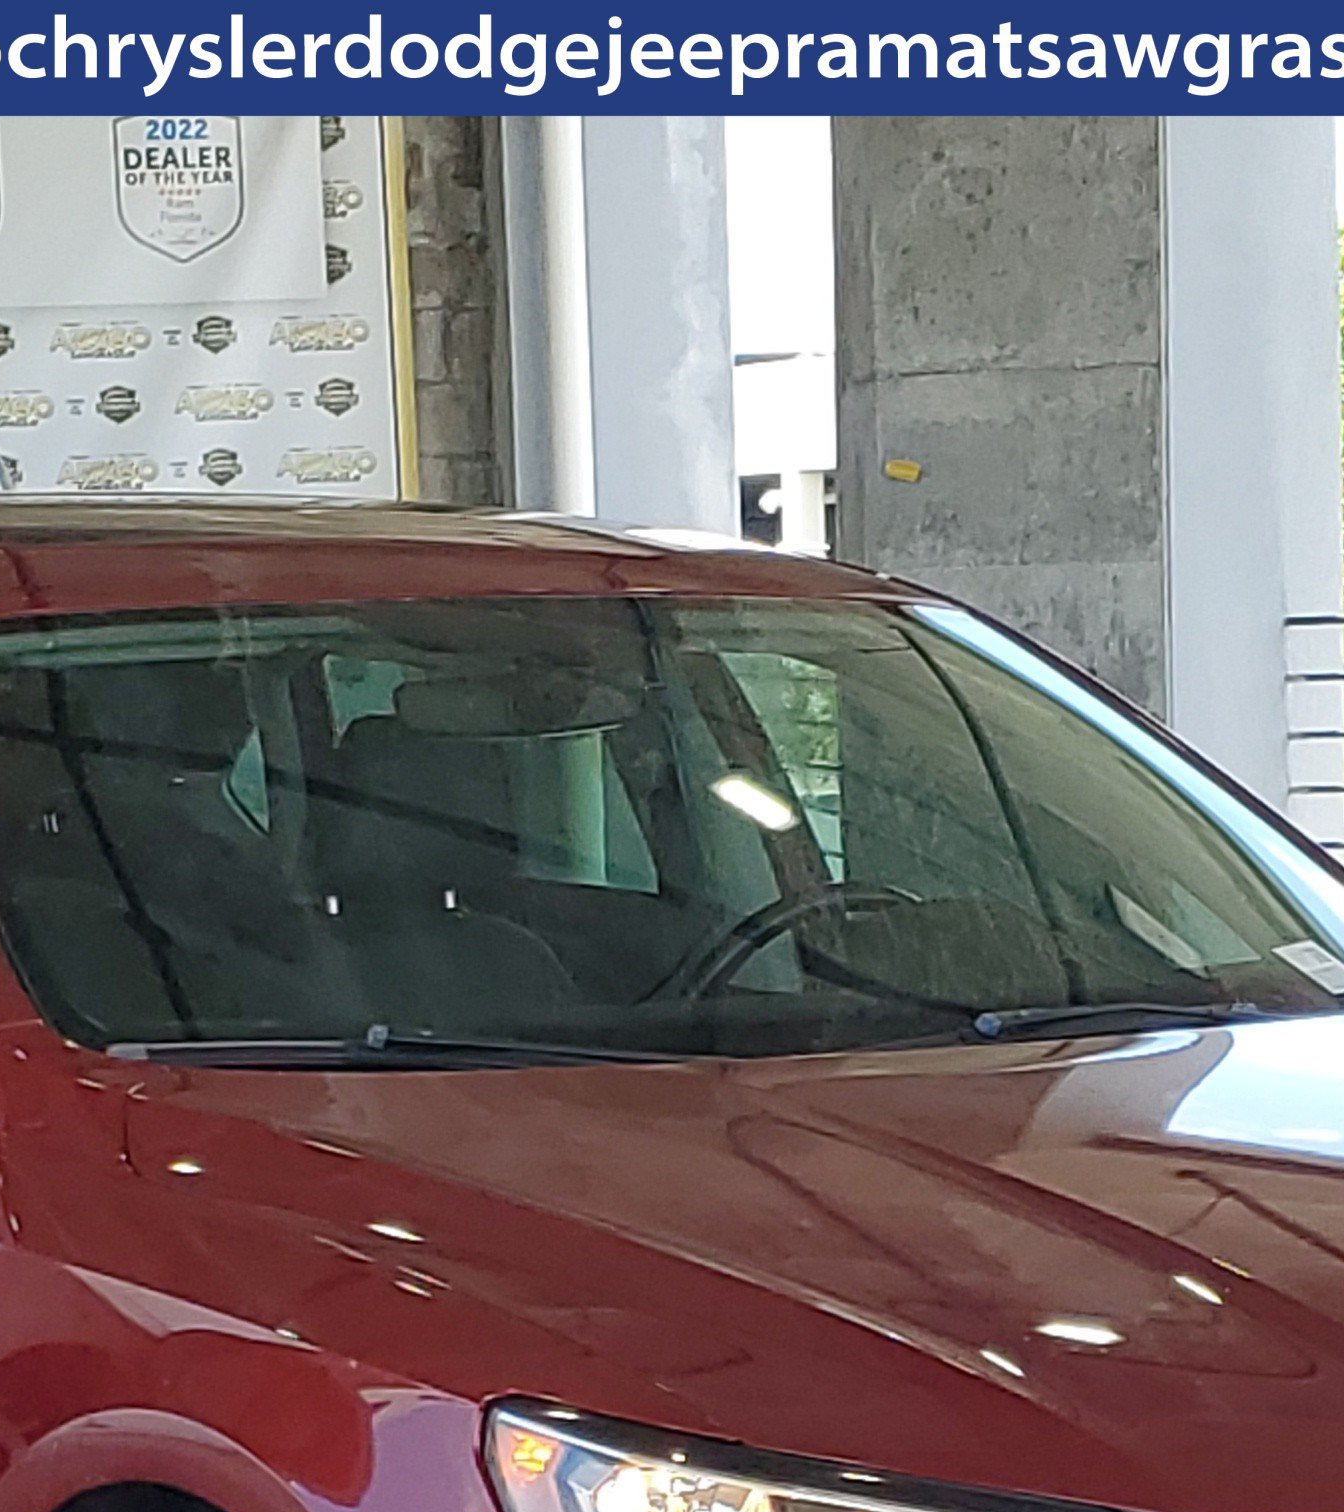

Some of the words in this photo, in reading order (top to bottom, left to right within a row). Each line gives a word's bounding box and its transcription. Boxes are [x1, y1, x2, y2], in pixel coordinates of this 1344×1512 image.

[146, 118, 208, 141] 2022
[123, 146, 232, 170] DEALER
[125, 172, 147, 186] OF
[152, 172, 185, 186] THE
[191, 171, 233, 184] YEAR
